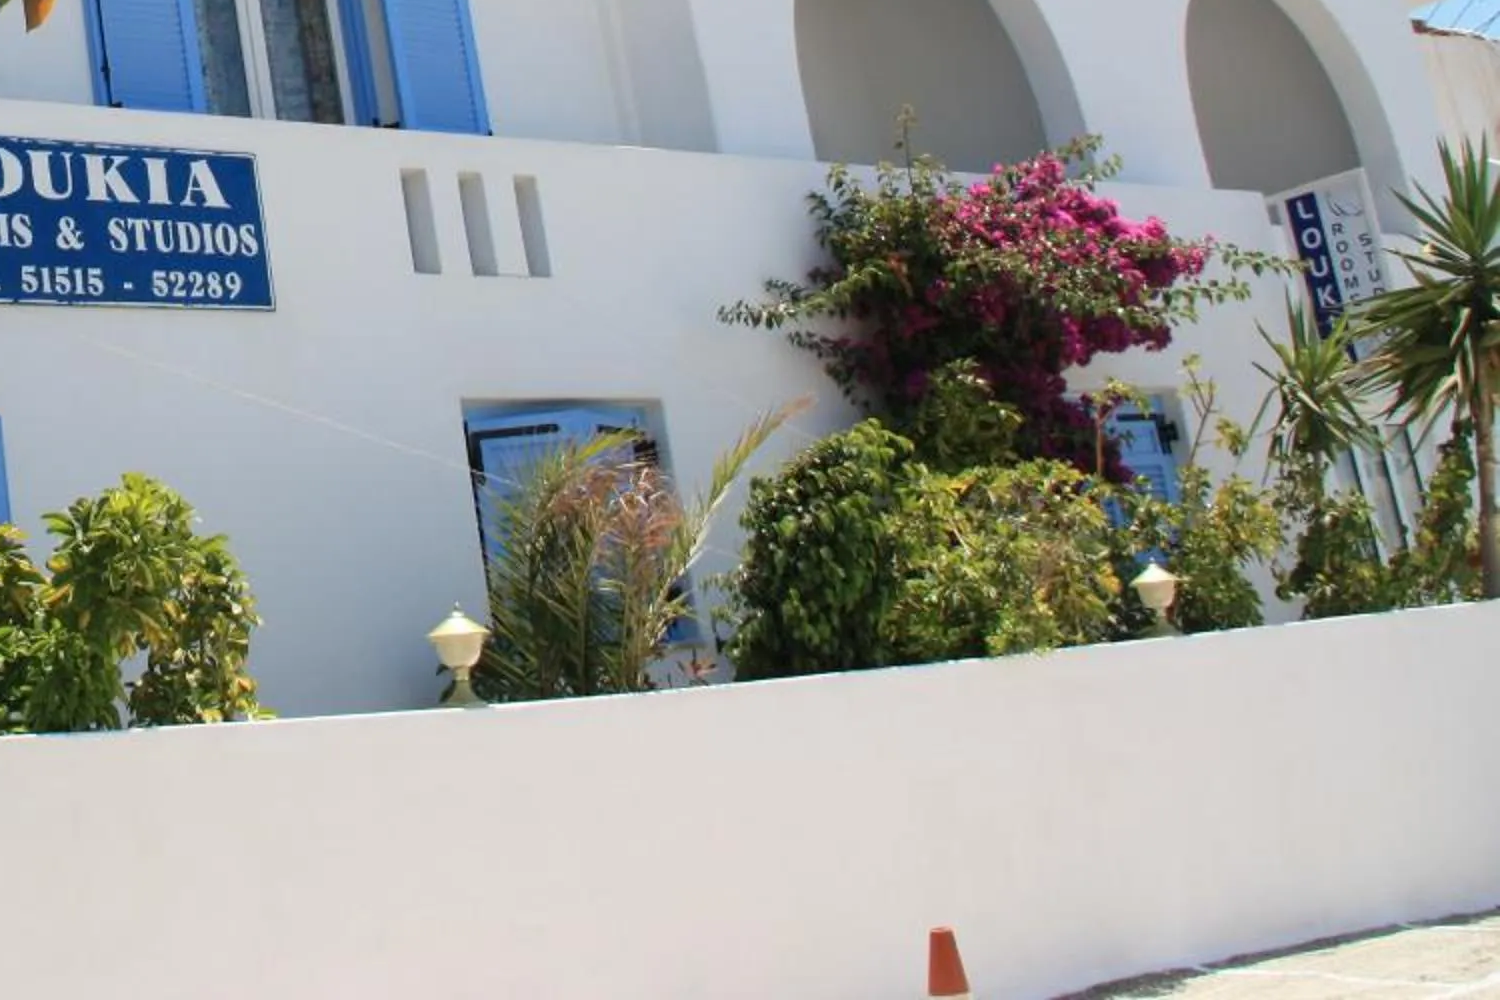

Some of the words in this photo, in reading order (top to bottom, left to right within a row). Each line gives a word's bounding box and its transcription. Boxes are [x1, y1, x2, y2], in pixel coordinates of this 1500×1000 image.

[56, 216, 85, 250] &
[108, 217, 259, 257] STUDIOS
[20, 265, 104, 295] 51515
[152, 270, 242, 299] 52289
[1296, 202, 1340, 328] LOUK
